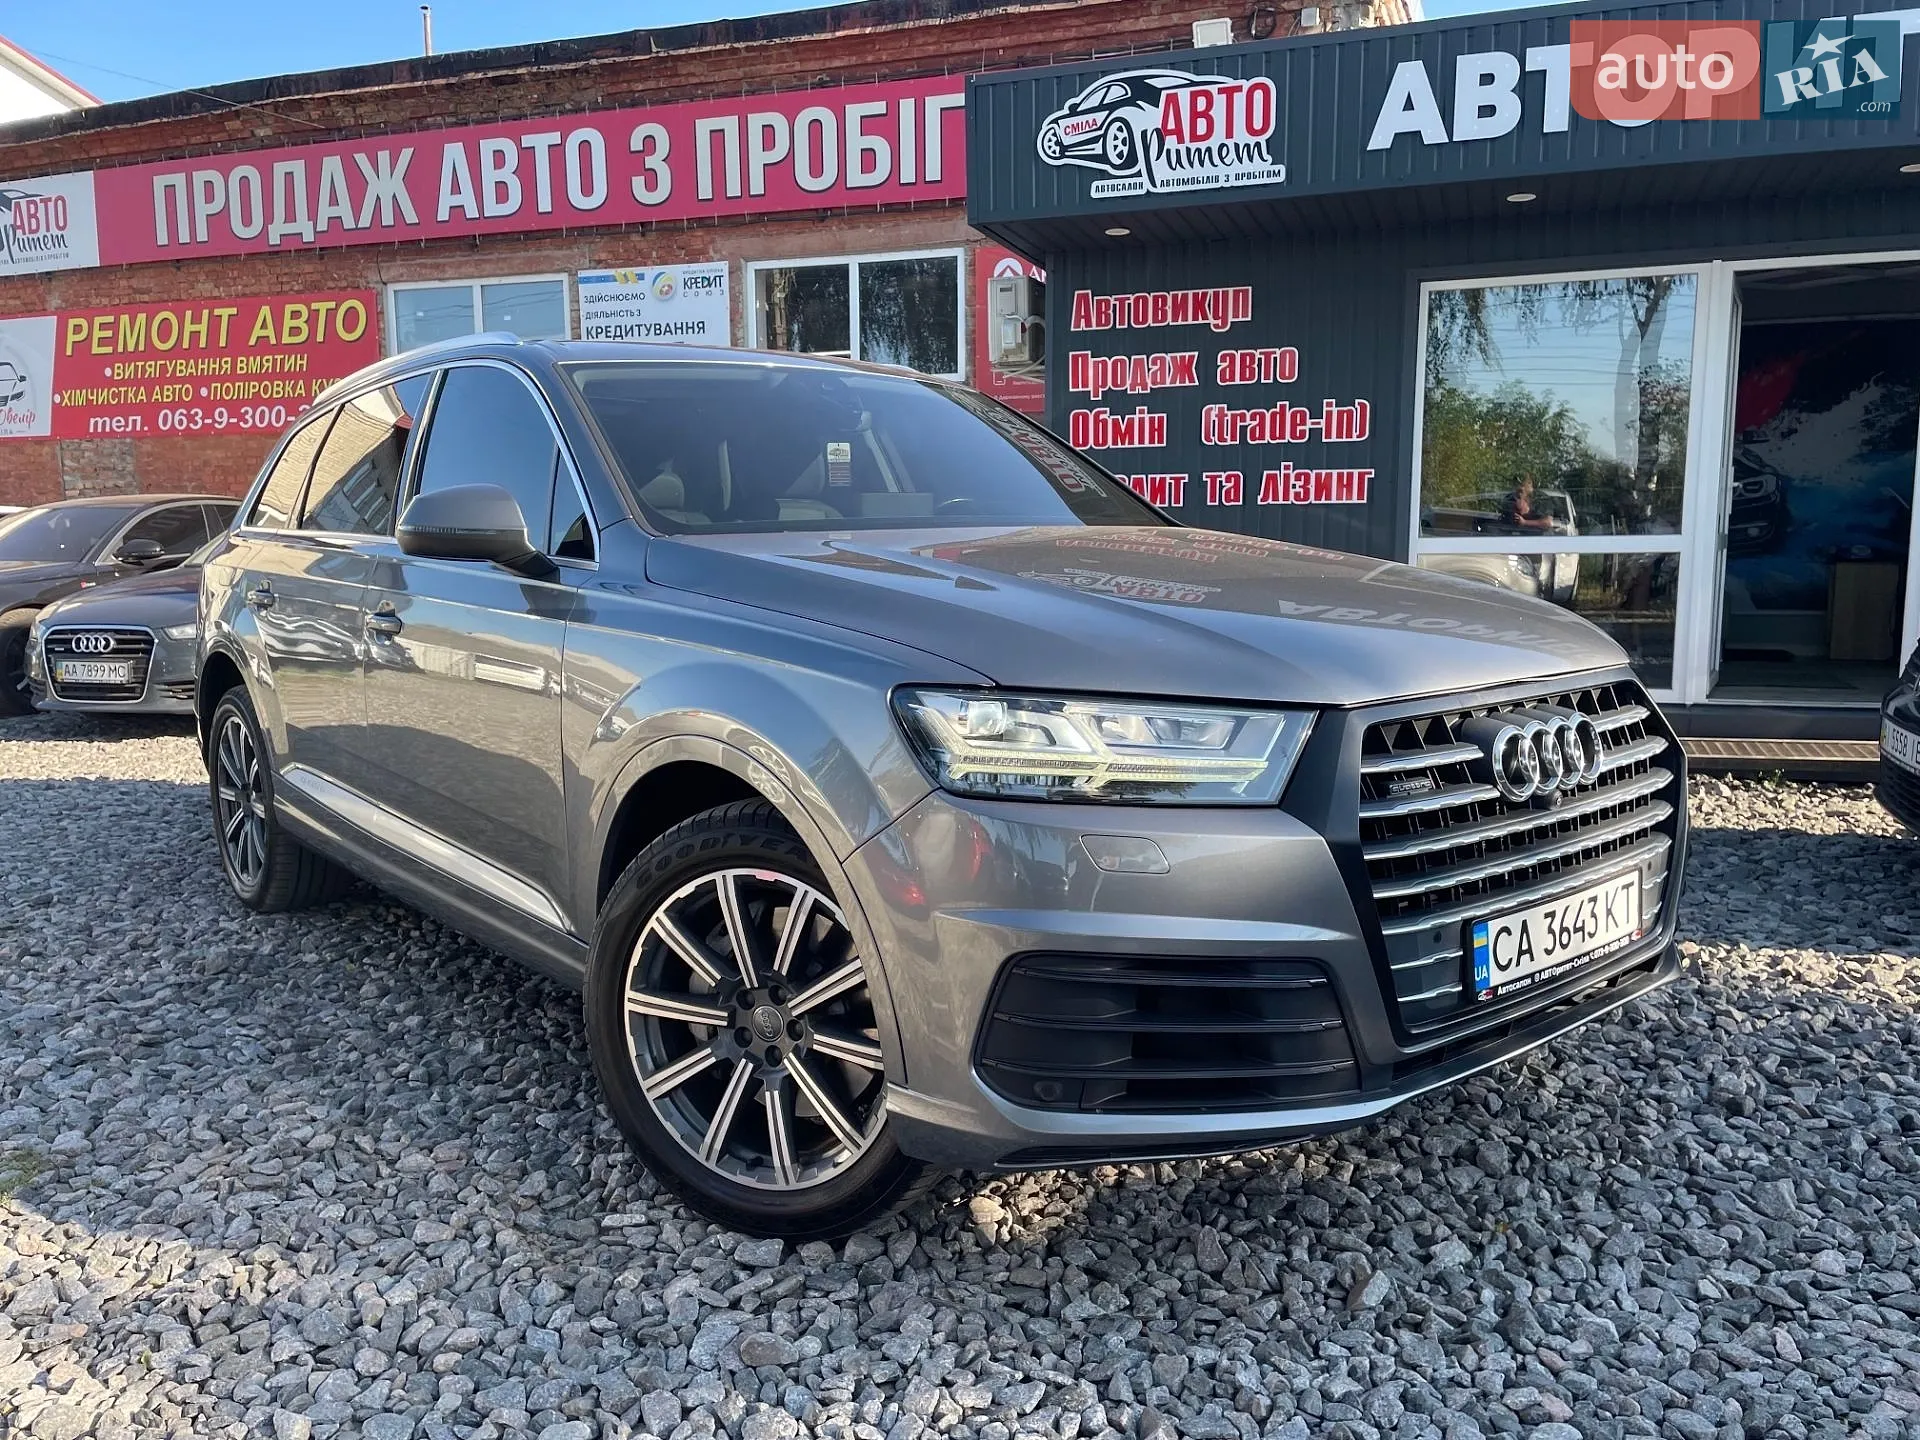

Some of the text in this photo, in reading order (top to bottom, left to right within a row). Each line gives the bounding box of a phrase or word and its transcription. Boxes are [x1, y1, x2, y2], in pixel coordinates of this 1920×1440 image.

[1160, 82, 1273, 144] АВТО
[1063, 118, 1098, 136] СМІЛА
[152, 92, 965, 247] ПРОДАЖ АВТО З ПРОБІГ
[1094, 181, 1144, 194] АВТОСАЛОН
[1159, 176, 1220, 188] АВТОМОБІЛІВ
[1234, 169, 1281, 181] ПРОБІГОМ
[13, 195, 68, 235] АВТО
[584, 292, 646, 304] ЗДІЙСНЮЄМО
[1071, 285, 1252, 332] Автовикуп
[65, 299, 368, 356] РЕМОНТ АВТО
[585, 309, 635, 320] ДІЯЛЬНІСТЬ
[586, 320, 706, 340] КРЕДИТУВАННЯ
[113, 353, 308, 380] ВИТЯГУВАННЯ ВМЯТИН
[1069, 347, 1299, 400] Продаж авто
[61, 386, 147, 407] ХІМЧИСТКА
[151, 384, 193, 402] АВТО
[210, 379, 306, 400] ПОЛІРОВКА
[89, 416, 149, 433] тел.
[1069, 399, 1370, 450] Обмін (trade-in)
[1203, 470, 1243, 506] та
[1258, 462, 1375, 505] лізинг
[64, 664, 126, 678] AA 7899 MC
[1492, 880, 1635, 972] CA 3643 KT
[1474, 966, 1489, 981] UA
[1497, 978, 1532, 996] Автосалон
